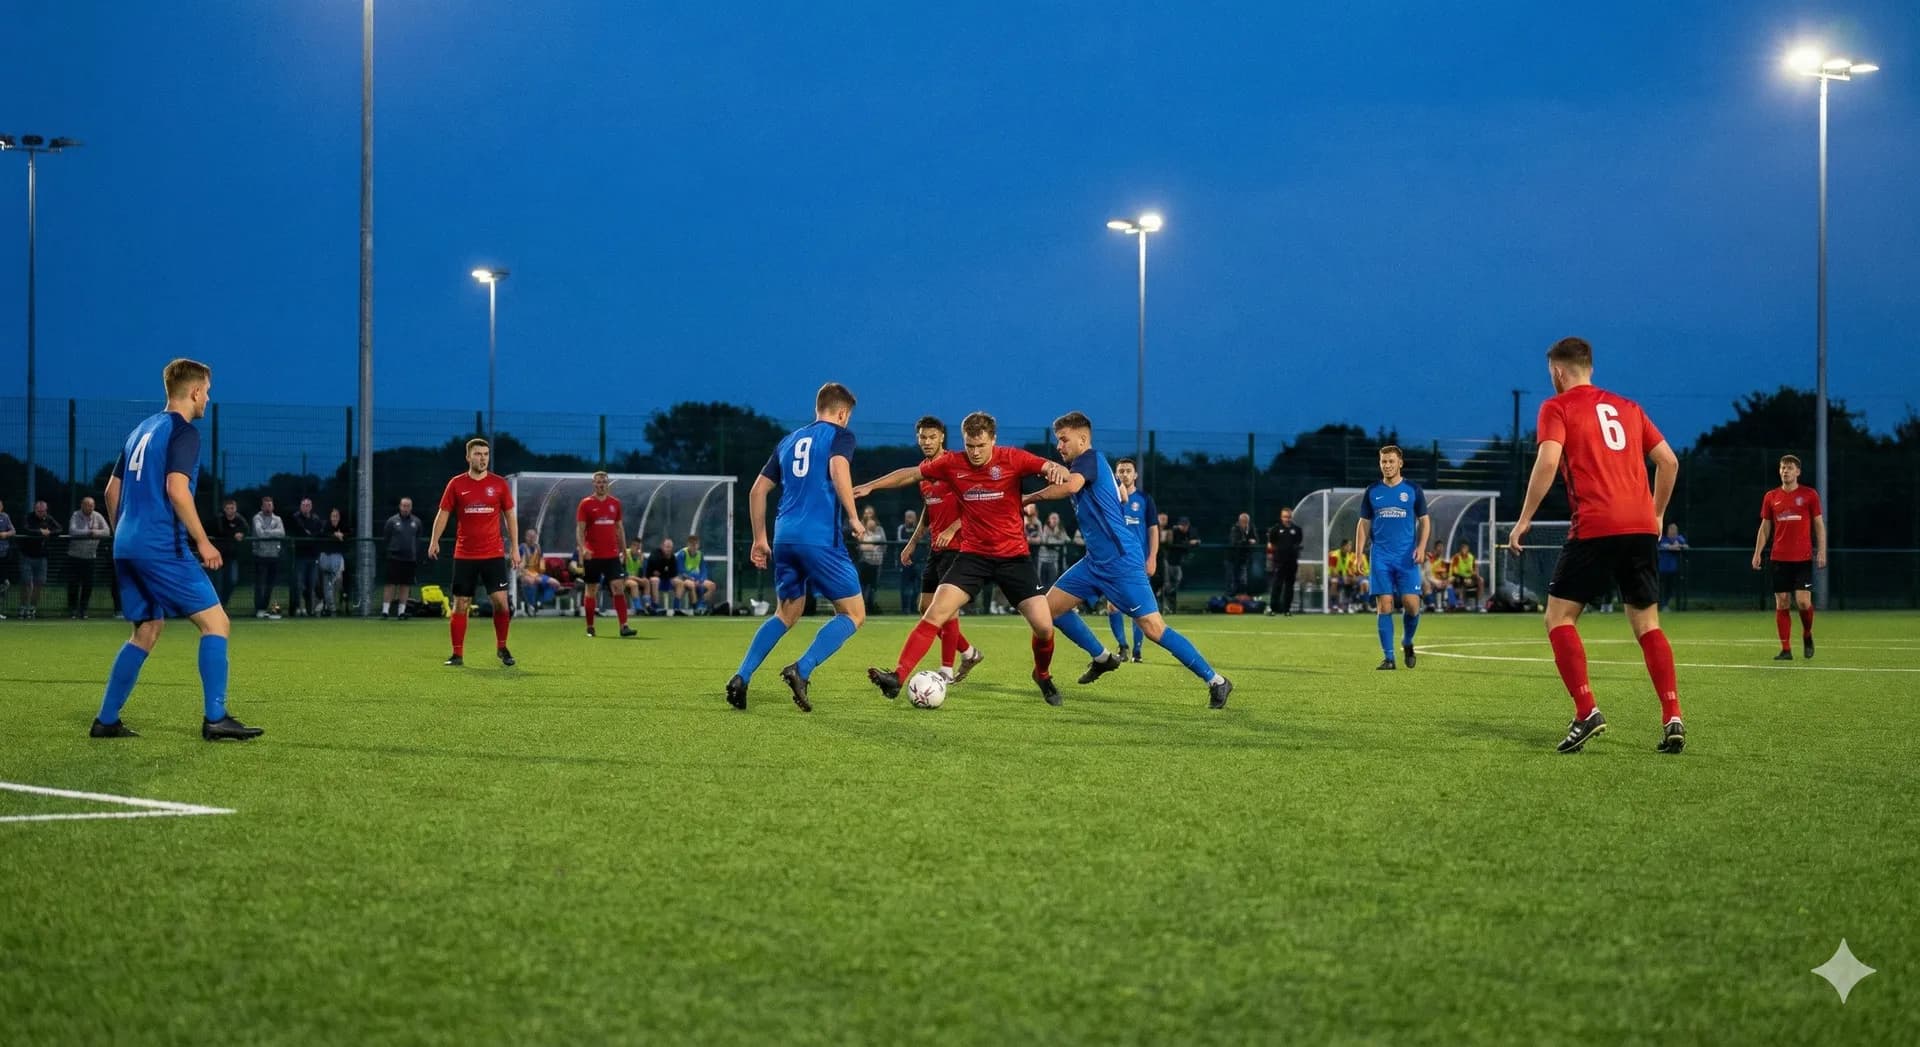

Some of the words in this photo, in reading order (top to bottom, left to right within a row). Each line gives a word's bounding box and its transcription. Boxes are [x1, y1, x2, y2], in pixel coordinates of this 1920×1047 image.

[1596, 403, 1626, 450] 6
[129, 432, 152, 481] 4
[793, 437, 812, 477] 9
